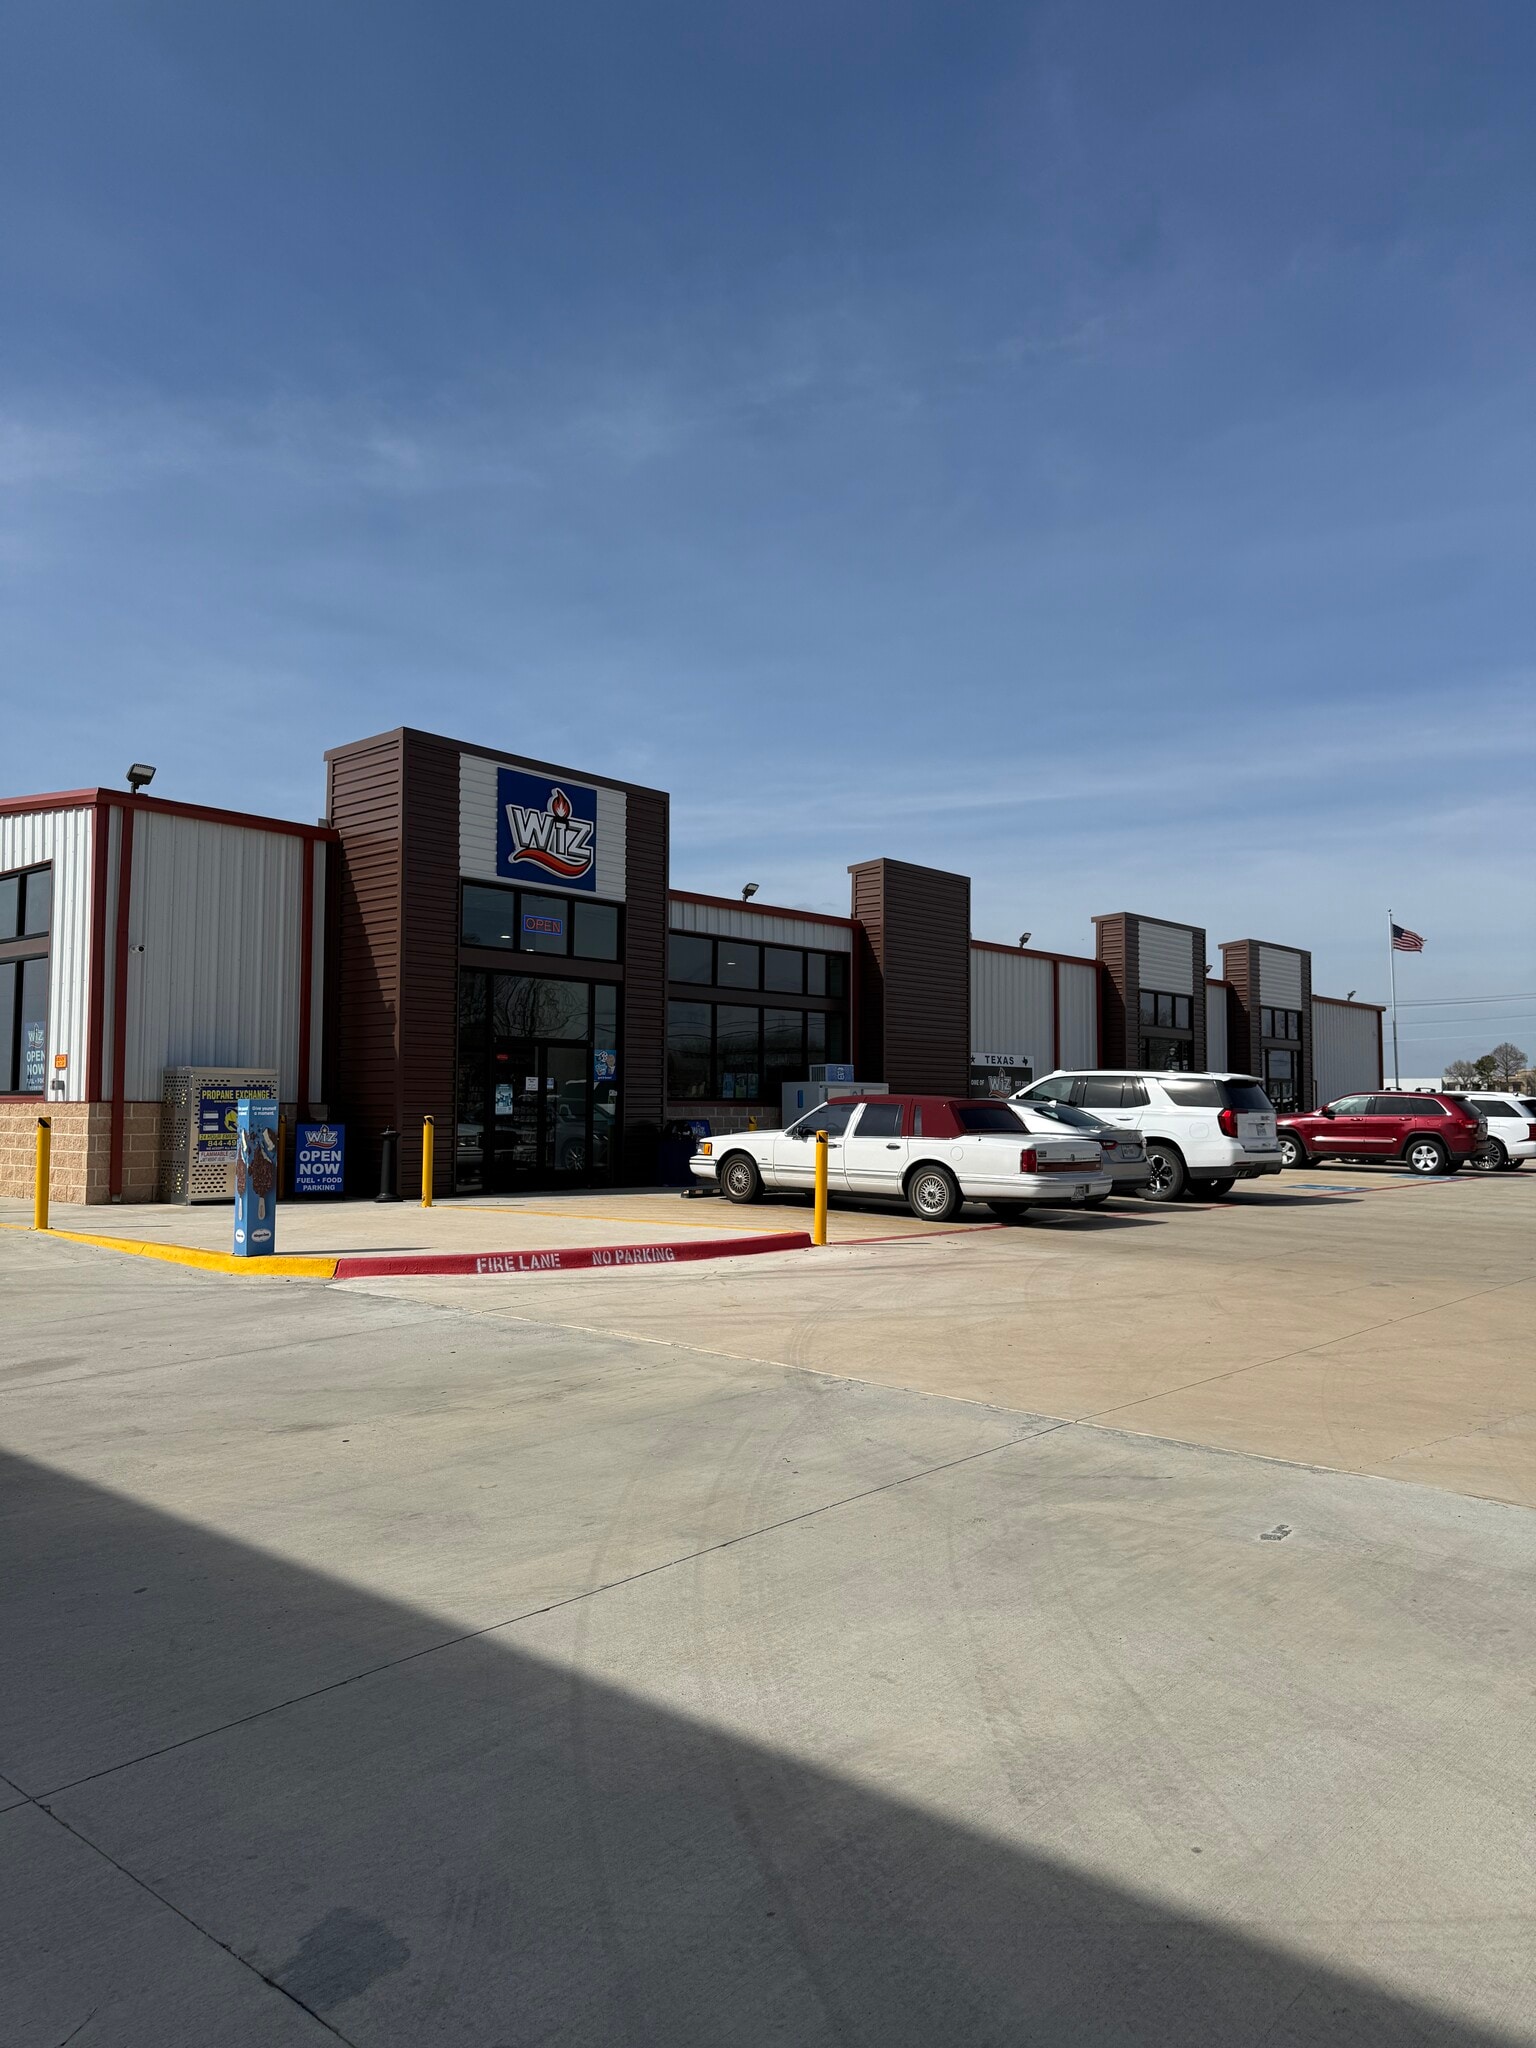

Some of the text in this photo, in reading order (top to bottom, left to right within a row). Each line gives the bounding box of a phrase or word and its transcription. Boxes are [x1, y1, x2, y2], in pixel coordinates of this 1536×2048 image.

[526, 917, 561, 933] OPEN
[985, 1055, 1014, 1065] TEXAS
[202, 1090, 270, 1100] PROPANE EXCHANGE
[299, 1150, 342, 1162] OPEN
[299, 1163, 340, 1175] NOW
[476, 1247, 675, 1274] FIRE LANE NO PARKING
